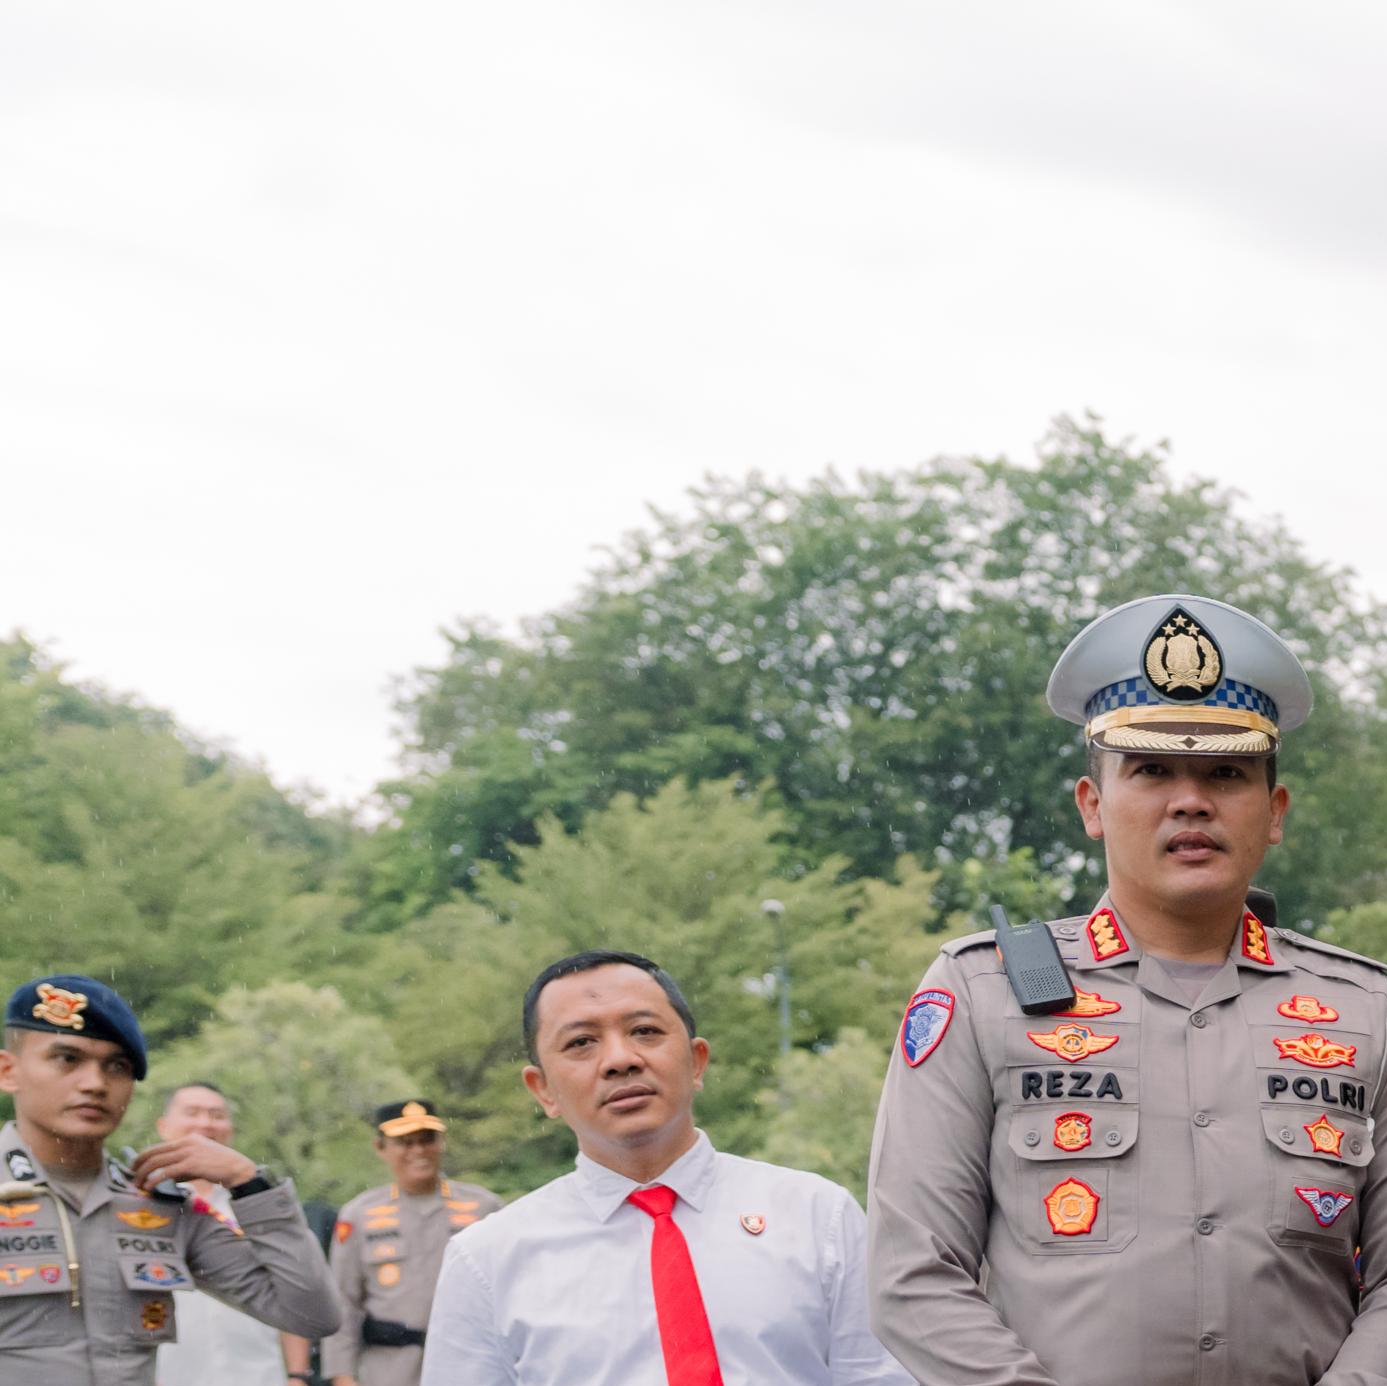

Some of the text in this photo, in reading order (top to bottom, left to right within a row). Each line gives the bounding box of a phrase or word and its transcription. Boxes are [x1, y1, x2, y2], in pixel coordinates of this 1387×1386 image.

[1022, 1070, 1123, 1100] REZA
[1267, 1074, 1365, 1111] POLRI
[118, 1237, 177, 1254] POLRI
